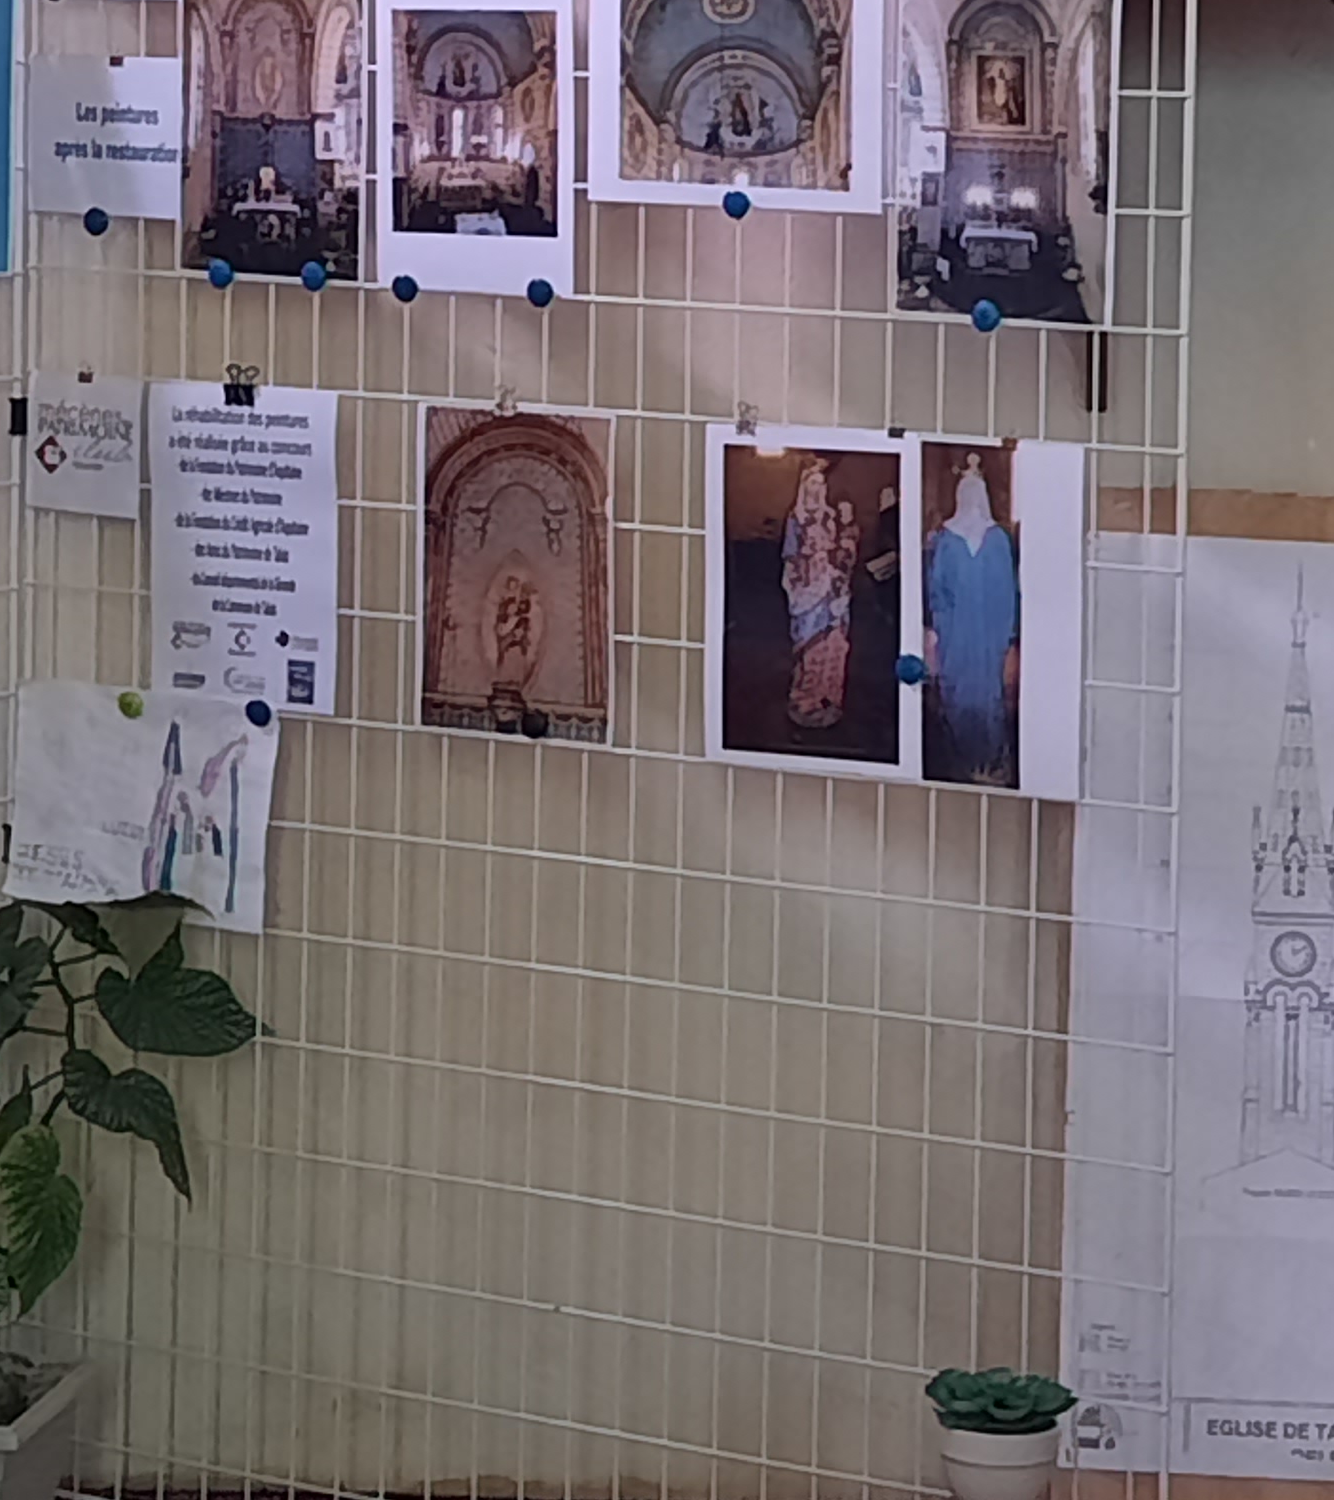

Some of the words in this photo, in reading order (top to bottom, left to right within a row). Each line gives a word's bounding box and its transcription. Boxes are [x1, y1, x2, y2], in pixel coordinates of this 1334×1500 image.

[75, 101, 99, 122] Les
[1206, 1418, 1278, 1440] EGLISE
[1282, 1423, 1310, 1440] DE
